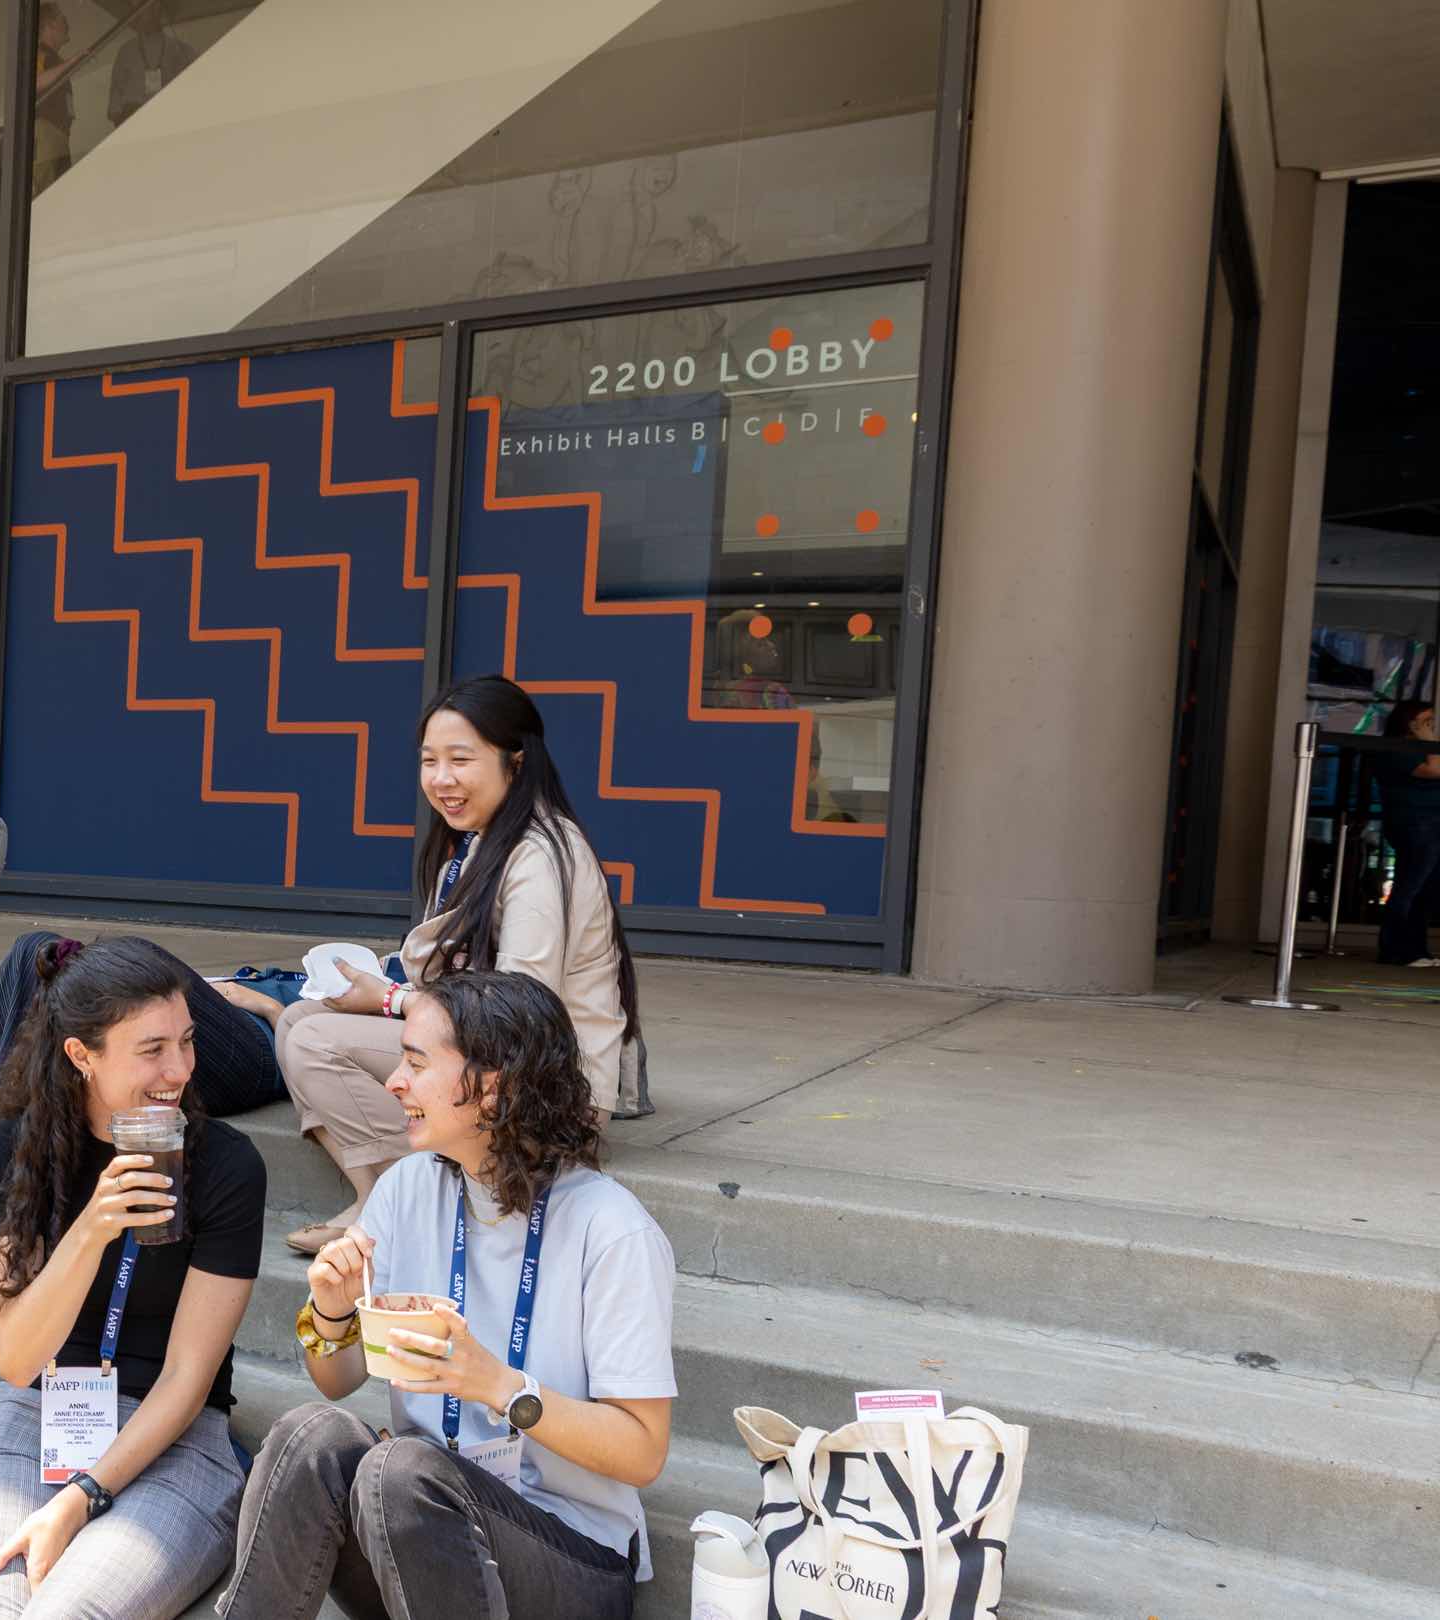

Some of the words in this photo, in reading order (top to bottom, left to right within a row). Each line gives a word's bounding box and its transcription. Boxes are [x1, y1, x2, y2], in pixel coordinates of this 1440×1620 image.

[588, 356, 696, 396] 2200
[720, 338, 875, 384] LOBBY
[500, 431, 593, 456] Exhibit
[607, 424, 676, 447] Halls
[691, 421, 706, 440] B
[743, 416, 761, 437] C
[800, 412, 818, 432] D
[118, 1262, 130, 1289] AAFP
[521, 1263, 534, 1294] AAFP
[106, 1312, 118, 1339] AAFP
[512, 1322, 526, 1353] AAFP
[51, 1381, 80, 1392] AAFP
[786, 1560, 827, 1581] NEW
[835, 1561, 853, 1571] THE
